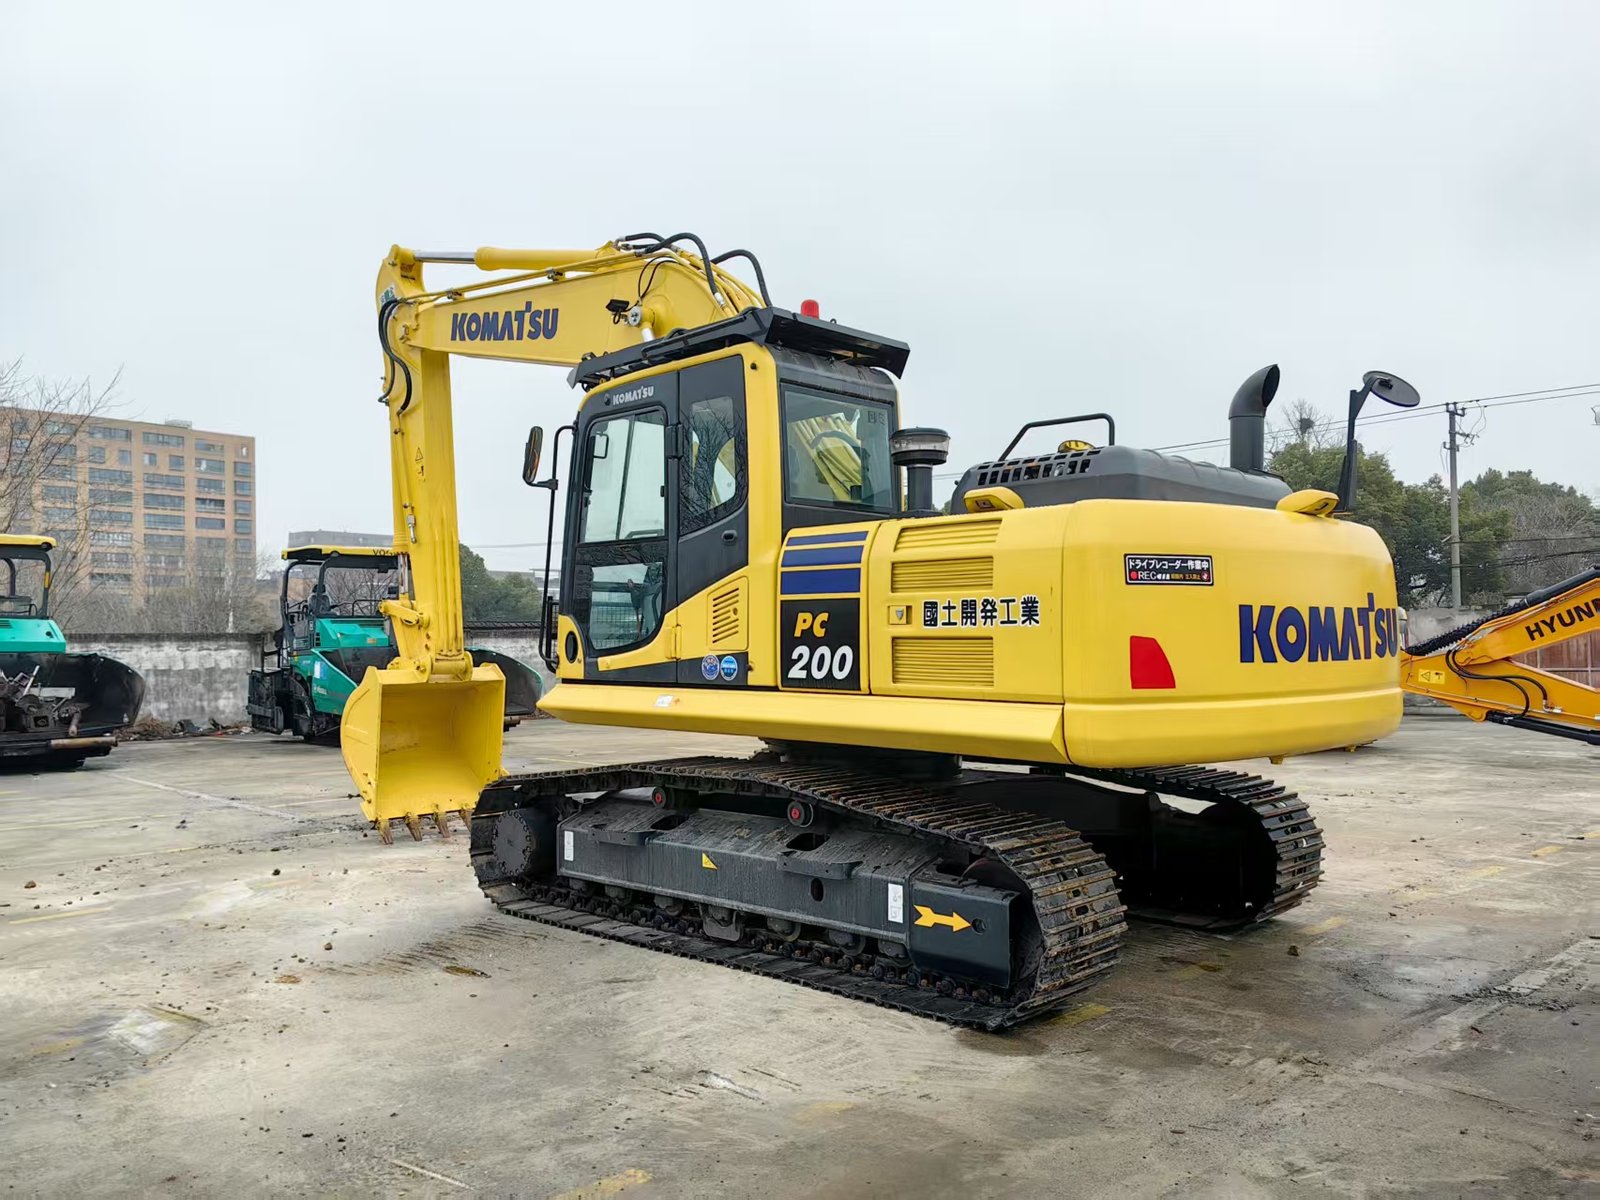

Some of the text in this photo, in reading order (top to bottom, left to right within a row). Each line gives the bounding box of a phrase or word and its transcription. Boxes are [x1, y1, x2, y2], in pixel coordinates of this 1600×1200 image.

[450, 301, 559, 341] KOMATSU
[612, 386, 655, 406] KOMATSU
[1138, 571, 1157, 580] REC
[793, 612, 830, 638] PC
[922, 596, 1040, 627] 國土開発工業
[1238, 592, 1398, 663] KOMATSU
[787, 645, 854, 680] 200
